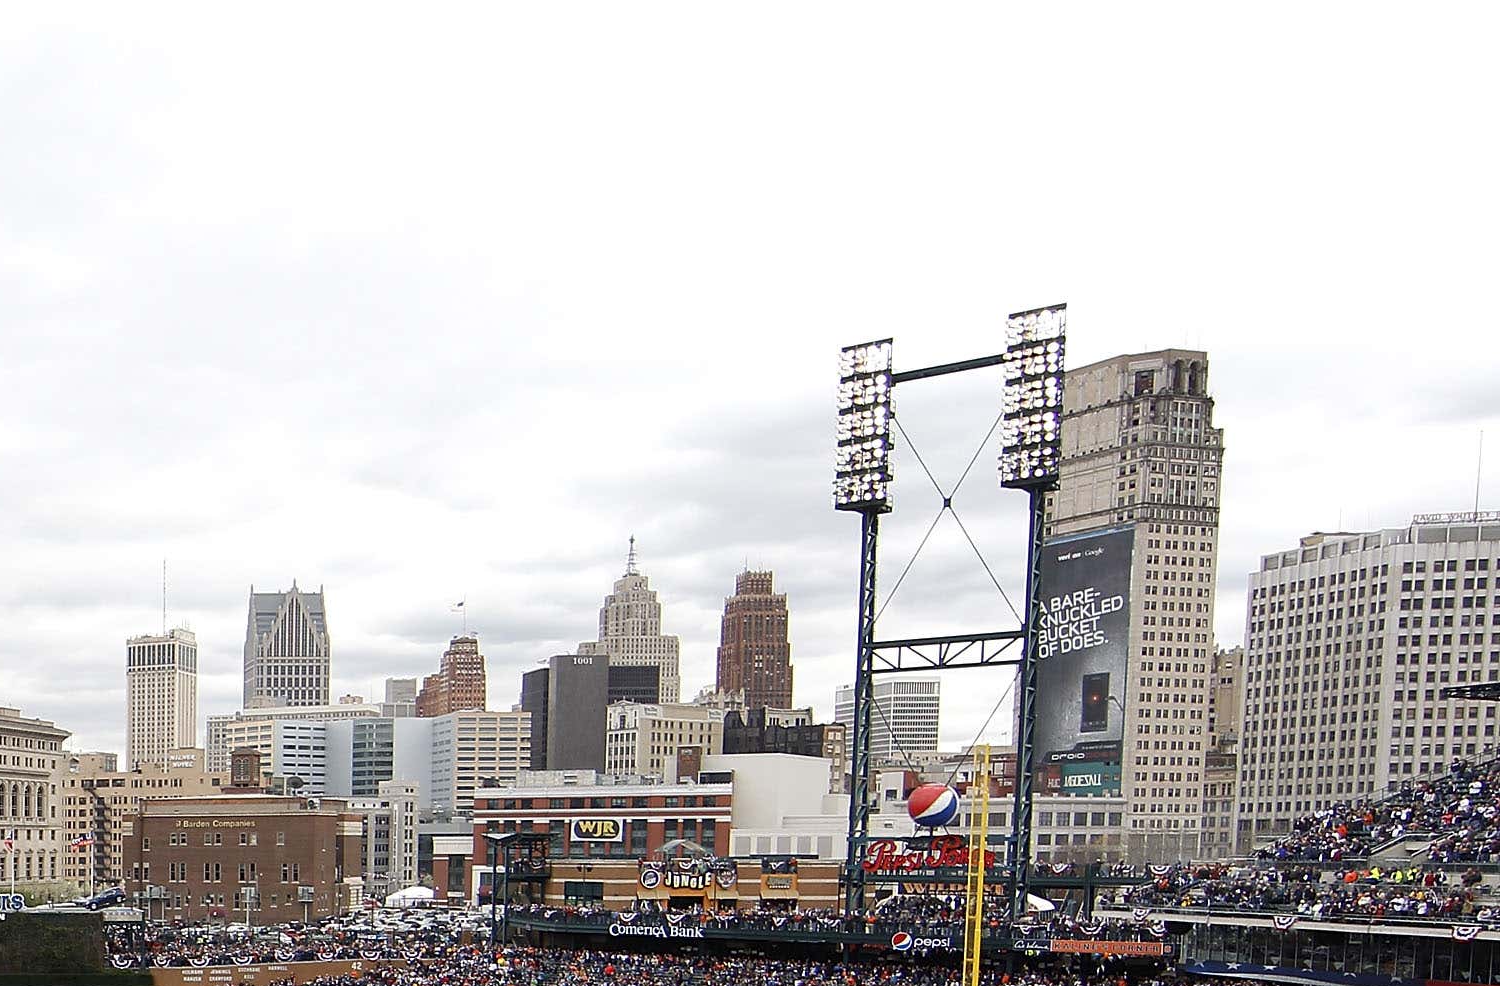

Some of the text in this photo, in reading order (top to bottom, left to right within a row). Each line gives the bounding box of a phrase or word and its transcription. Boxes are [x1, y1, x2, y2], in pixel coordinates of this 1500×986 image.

[1040, 588, 1100, 614] A BARE-
[1038, 616, 1100, 644] BUCKET
[1038, 630, 1109, 658] OF DOES.
[183, 819, 256, 828] Barden Companies
[578, 819, 616, 837] WJR
[664, 871, 712, 890] JUNGLE
[669, 925, 705, 938] Bank
[913, 937, 950, 948] pepsi
[351, 961, 362, 970] 42
